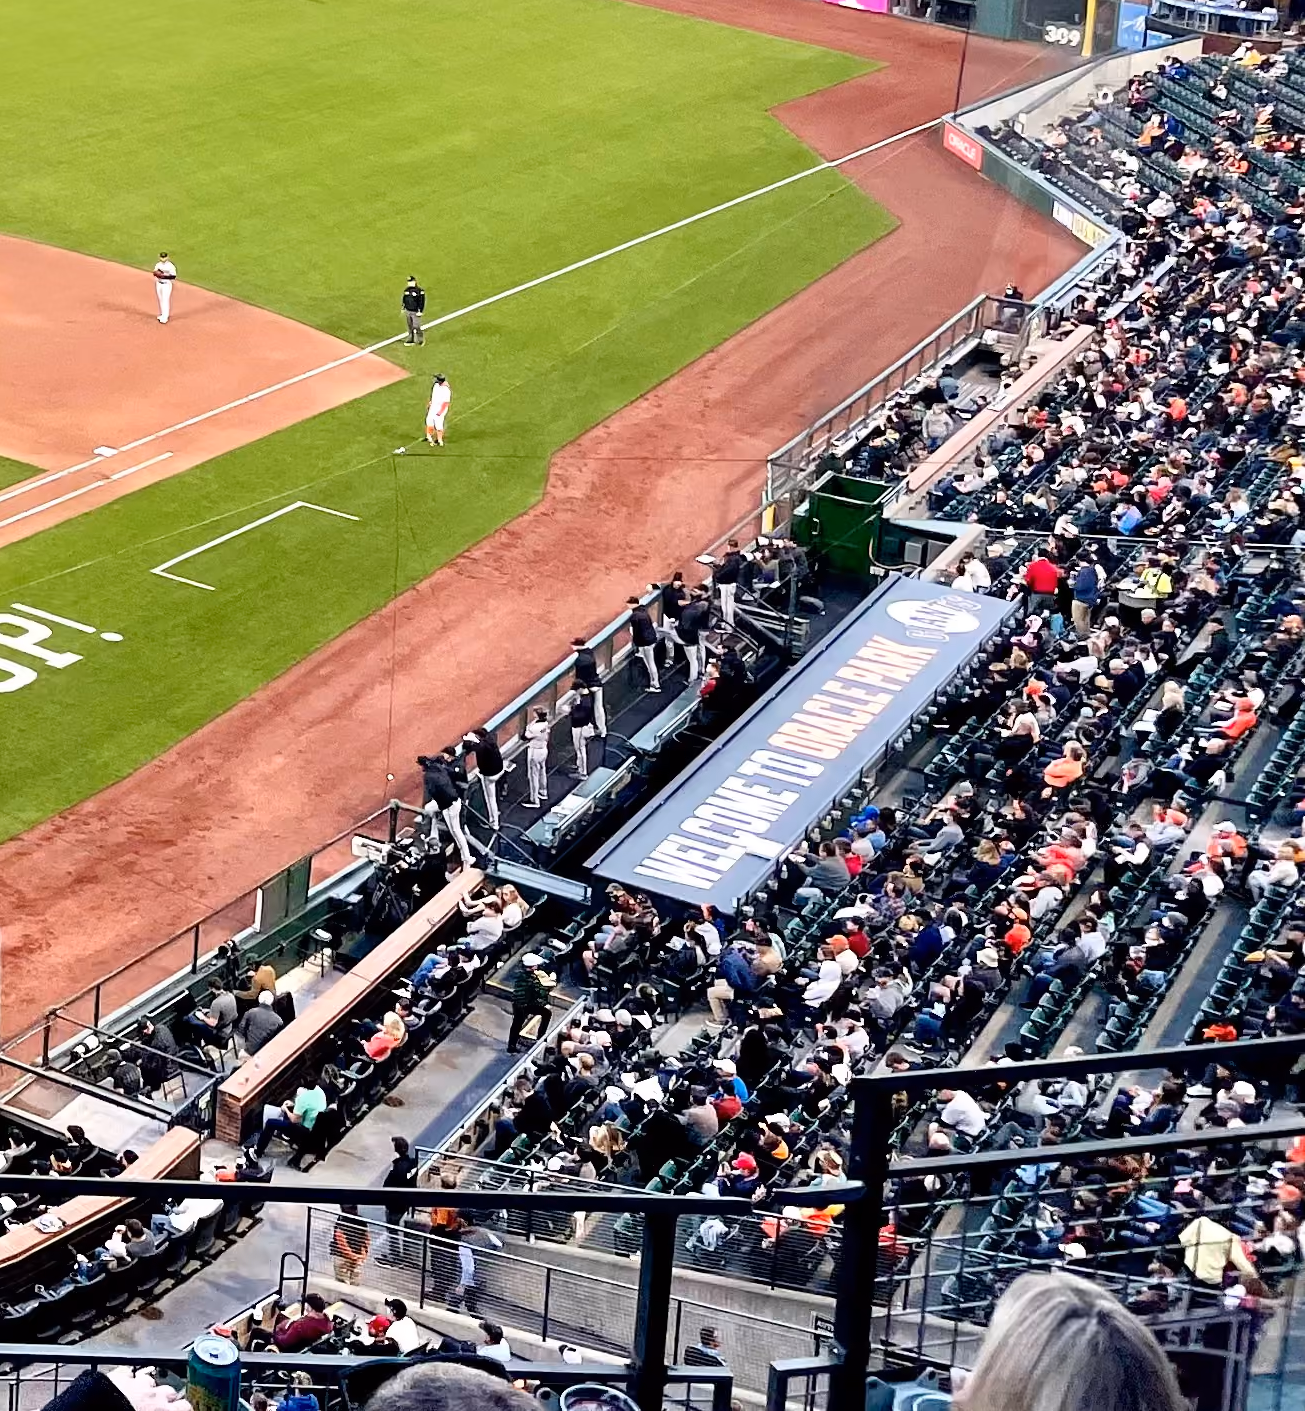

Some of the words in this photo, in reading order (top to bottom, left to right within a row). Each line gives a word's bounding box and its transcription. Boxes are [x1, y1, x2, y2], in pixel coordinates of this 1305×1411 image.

[1044, 25, 1081, 47] 309
[948, 132, 977, 160] ORACLE
[835, 635, 938, 692] PARK
[767, 680, 895, 760] ORACLE
[736, 749, 825, 788] TO
[633, 776, 799, 890] WELCOME
